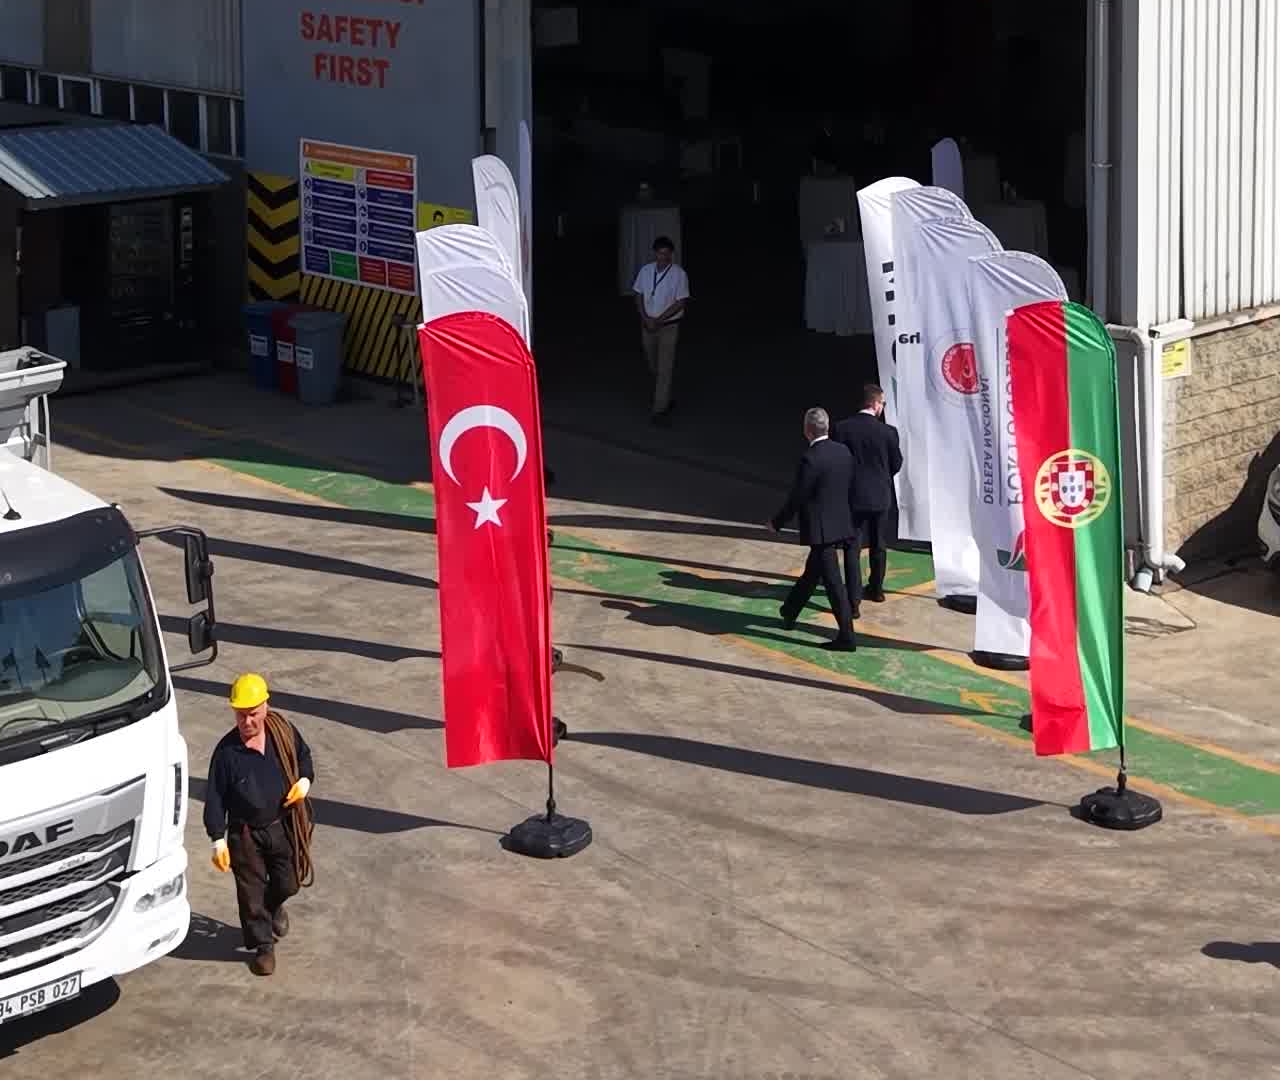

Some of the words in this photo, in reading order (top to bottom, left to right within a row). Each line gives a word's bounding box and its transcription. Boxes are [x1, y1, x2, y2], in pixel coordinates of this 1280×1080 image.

[300, 11, 401, 49] SAFETY
[314, 53, 389, 88] FIRST
[20, 989, 46, 1011] PSB
[52, 977, 77, 999] 027
